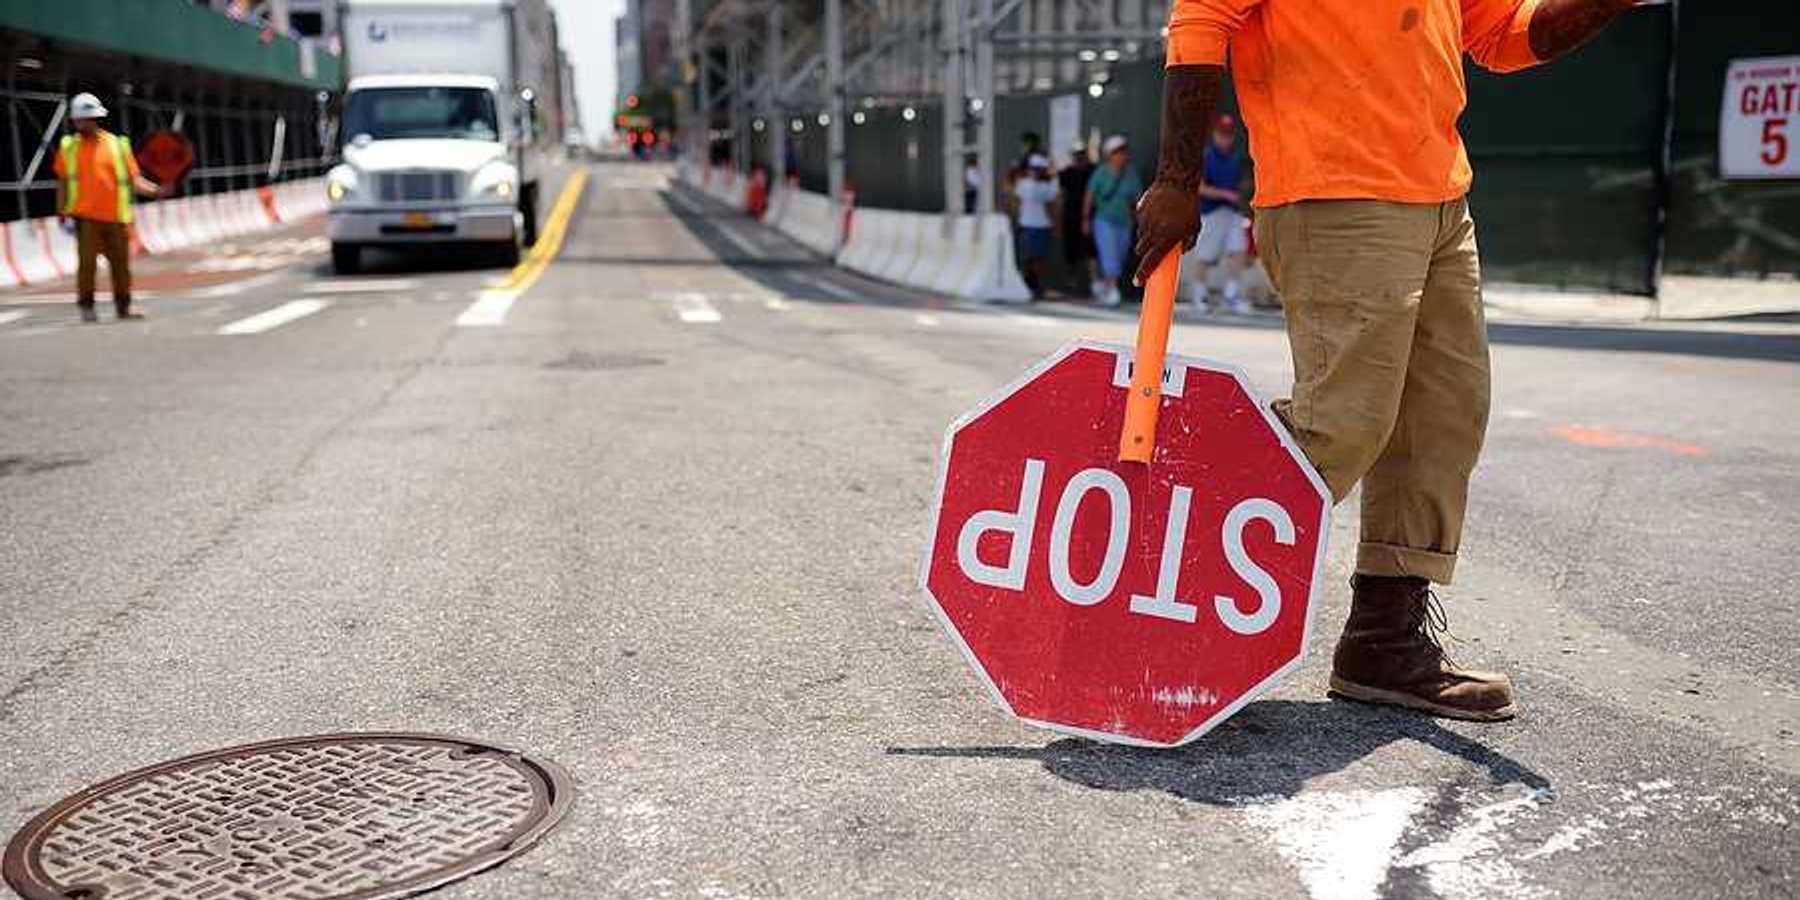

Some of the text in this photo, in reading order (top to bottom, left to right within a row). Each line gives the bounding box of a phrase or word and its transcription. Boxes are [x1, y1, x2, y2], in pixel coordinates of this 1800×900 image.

[1741, 83, 1800, 115] GAT
[1760, 118, 1788, 166] 5
[957, 458, 1296, 635] STOP
[291, 766, 444, 820] SEWER
